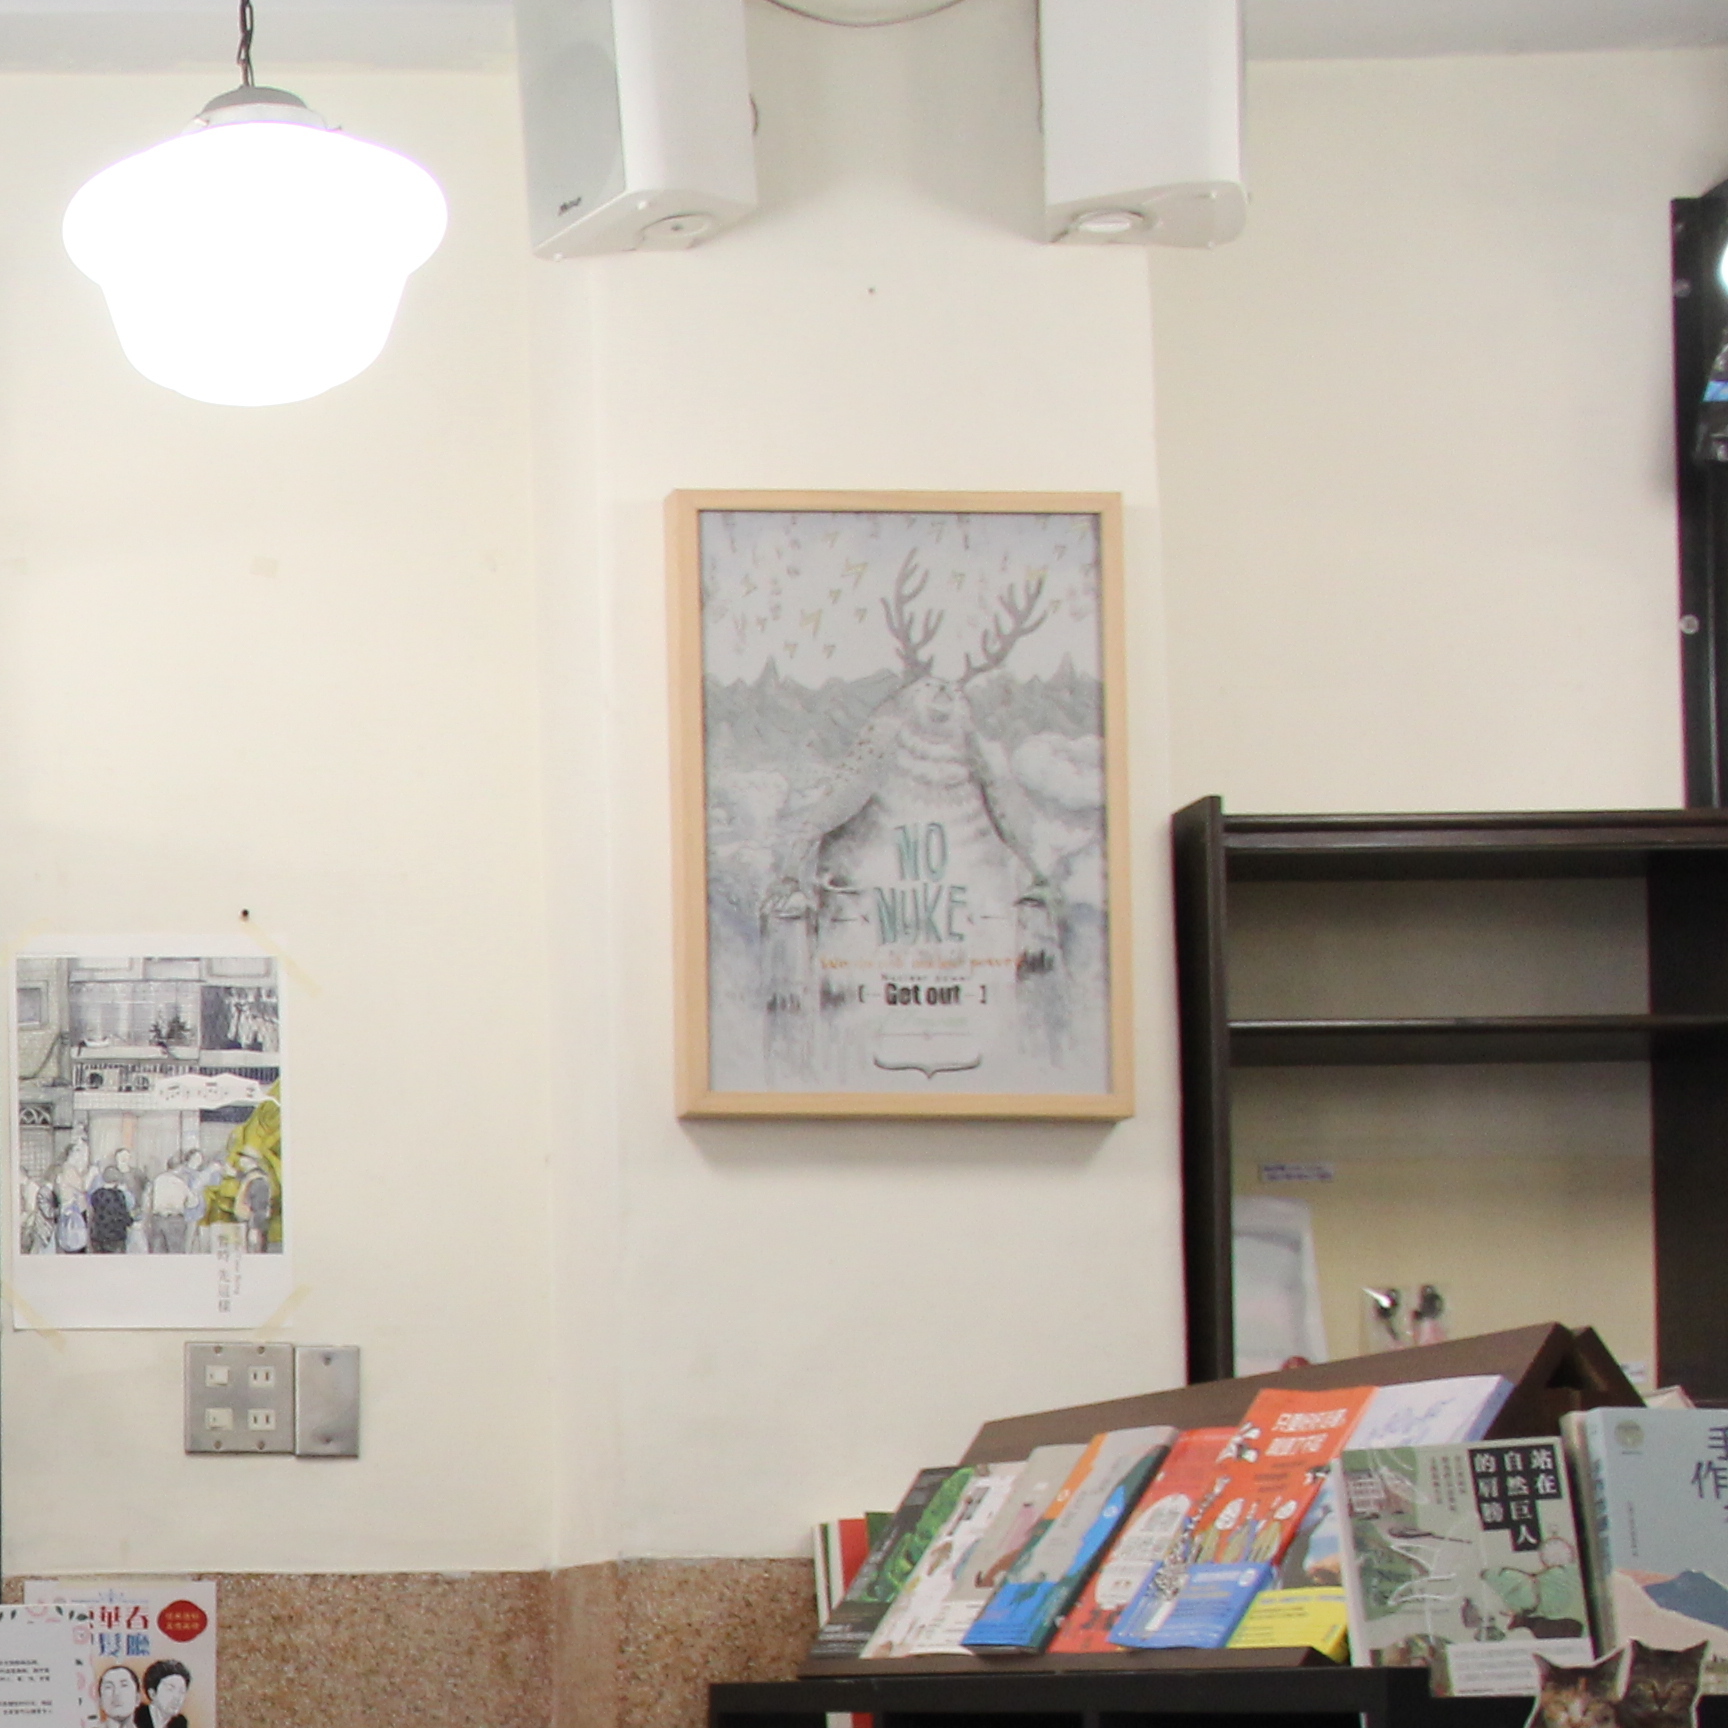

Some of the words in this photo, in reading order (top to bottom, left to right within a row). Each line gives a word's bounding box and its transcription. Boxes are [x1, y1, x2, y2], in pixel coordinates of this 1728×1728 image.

[895, 823, 947, 882] NO
[873, 882, 967, 945] NUKE
[885, 983, 921, 1005] Get
[926, 985, 960, 1005] out
